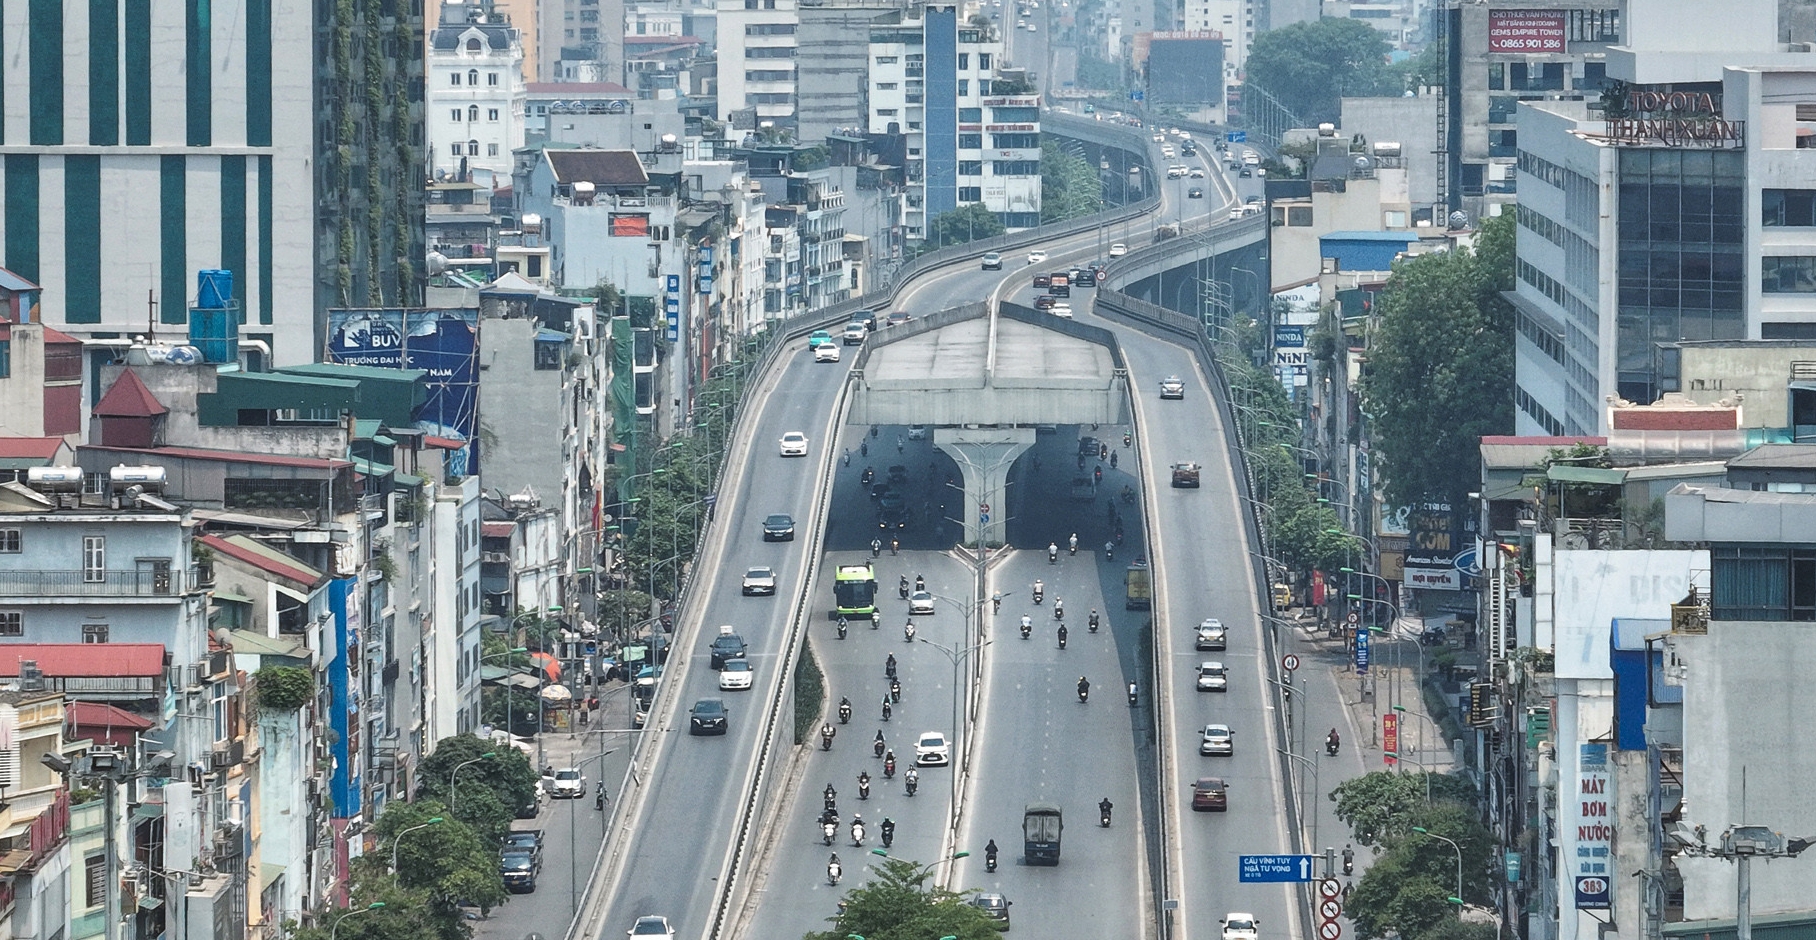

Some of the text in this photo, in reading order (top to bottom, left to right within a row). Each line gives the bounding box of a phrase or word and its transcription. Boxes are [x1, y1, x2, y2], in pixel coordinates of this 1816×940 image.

[1500, 39, 1561, 48] 0865 901 586
[1630, 91, 1715, 113] TOYOTA
[1608, 119, 1676, 138] THANH
[372, 334, 401, 347] BUV
[430, 368, 452, 376] NAM
[1582, 774, 1606, 794] MÁY
[1582, 800, 1607, 816] BƠM
[1578, 821, 1610, 841] NƯỚC
